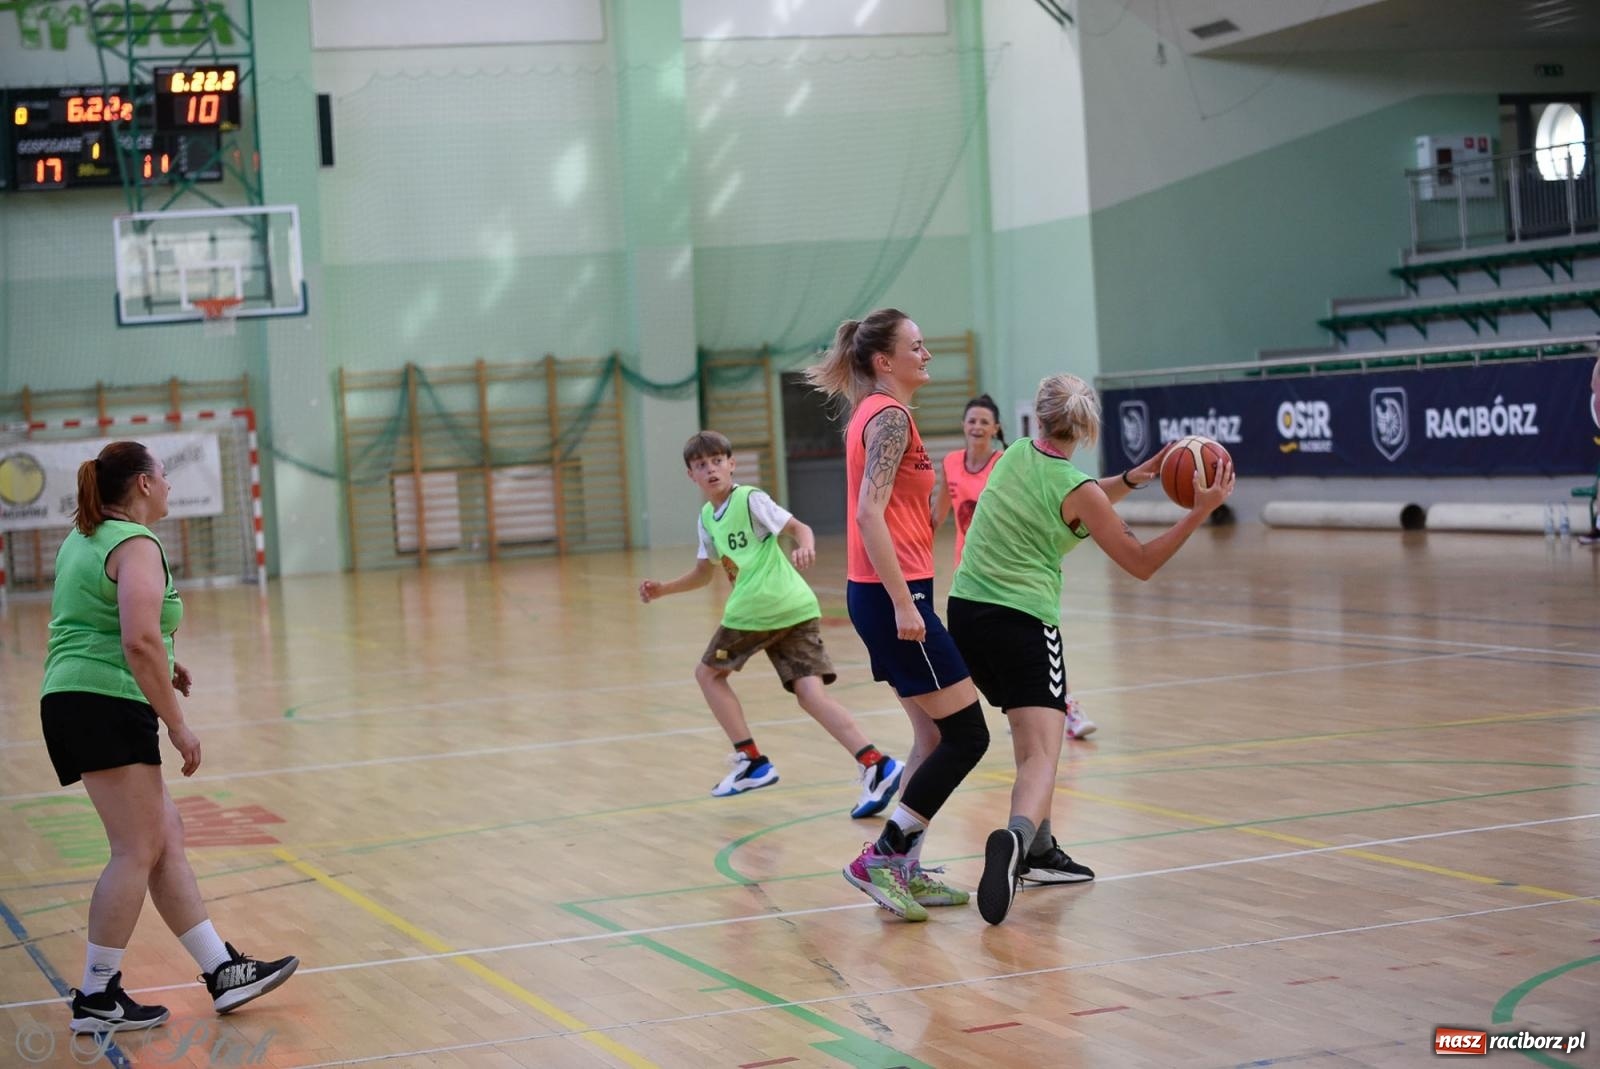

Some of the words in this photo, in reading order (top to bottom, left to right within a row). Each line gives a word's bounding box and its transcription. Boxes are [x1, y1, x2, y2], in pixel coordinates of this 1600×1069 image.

[187, 94, 220, 124] 10
[35, 157, 63, 183] 17
[1159, 408, 1242, 443] RACIBÓRZ
[1425, 395, 1539, 438] RACIBÓRZ
[727, 531, 748, 550] 63
